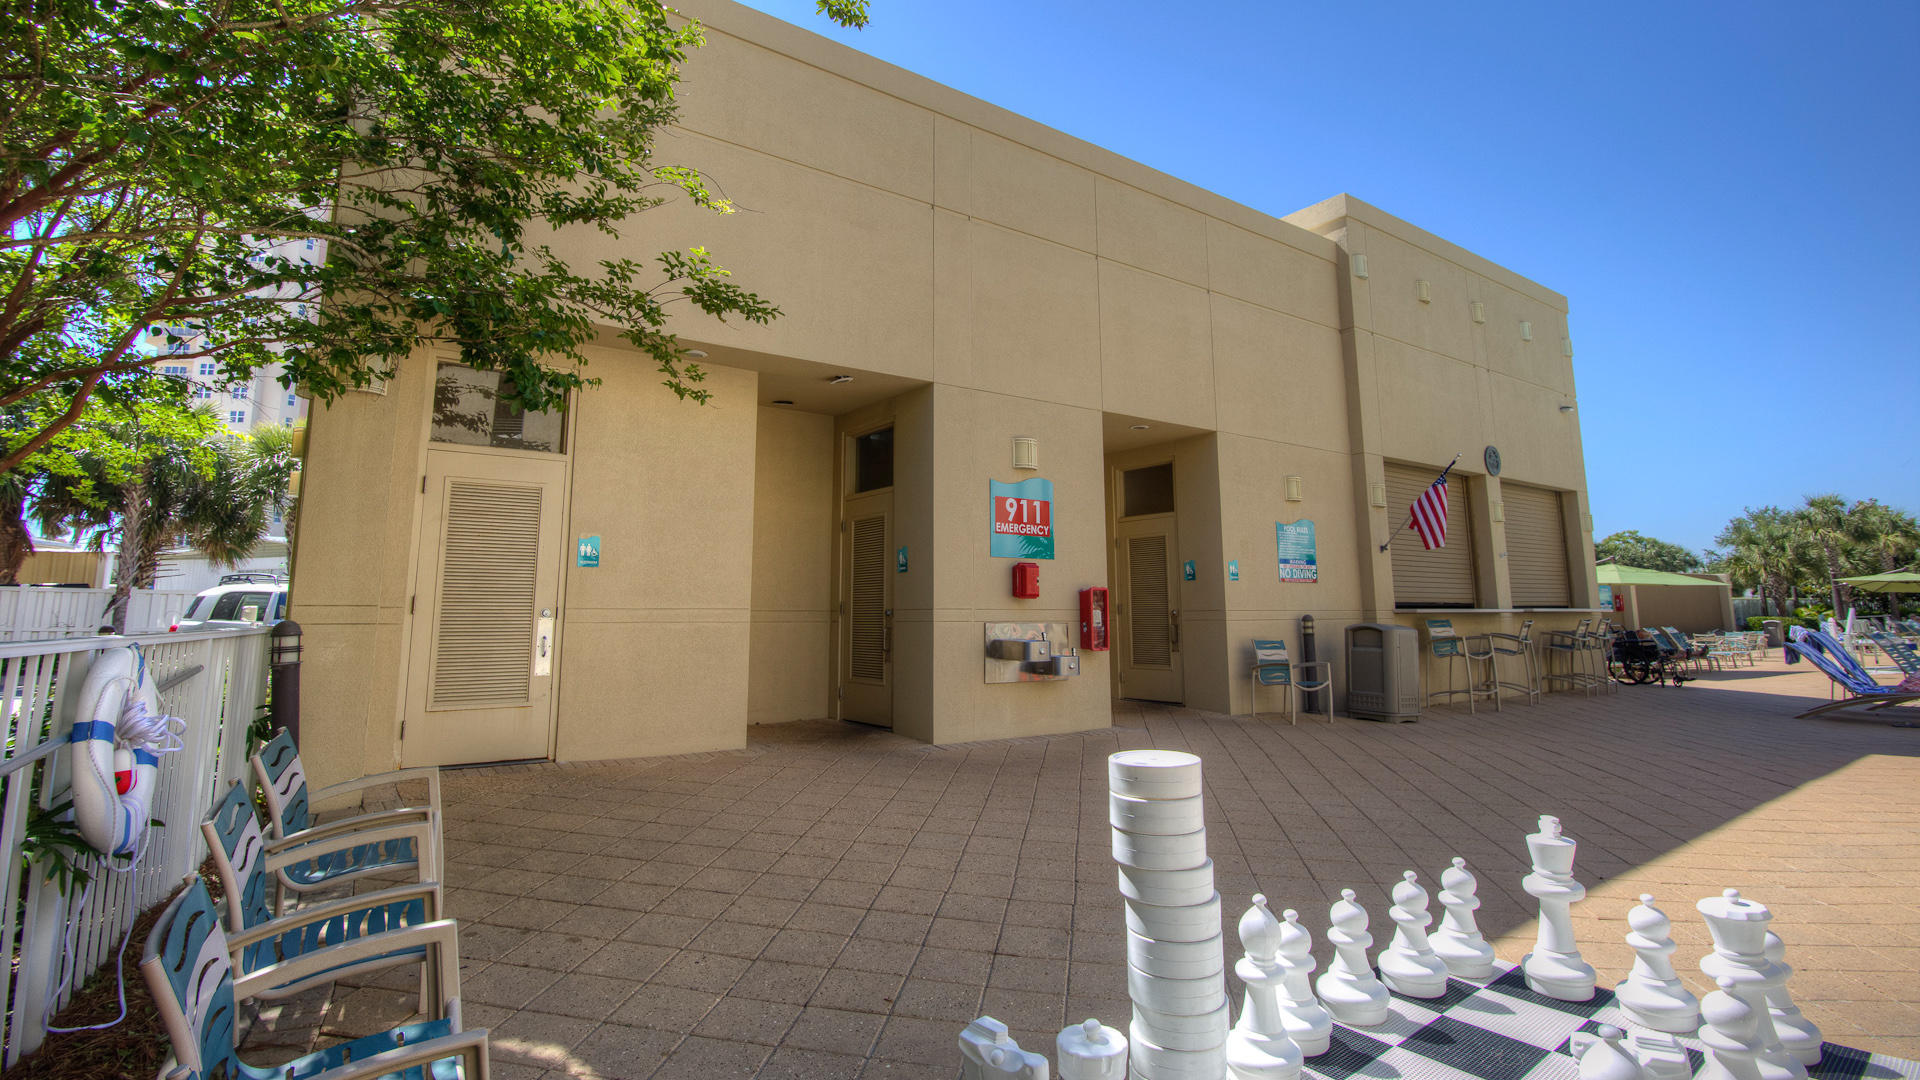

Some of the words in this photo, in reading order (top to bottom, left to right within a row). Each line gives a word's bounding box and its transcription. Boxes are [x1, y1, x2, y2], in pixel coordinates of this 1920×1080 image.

[1005, 498, 1041, 524] 911
[996, 522, 1049, 535] EMERGENCY
[1280, 568, 1291, 578] NO
[1293, 568, 1317, 579] DIVING
